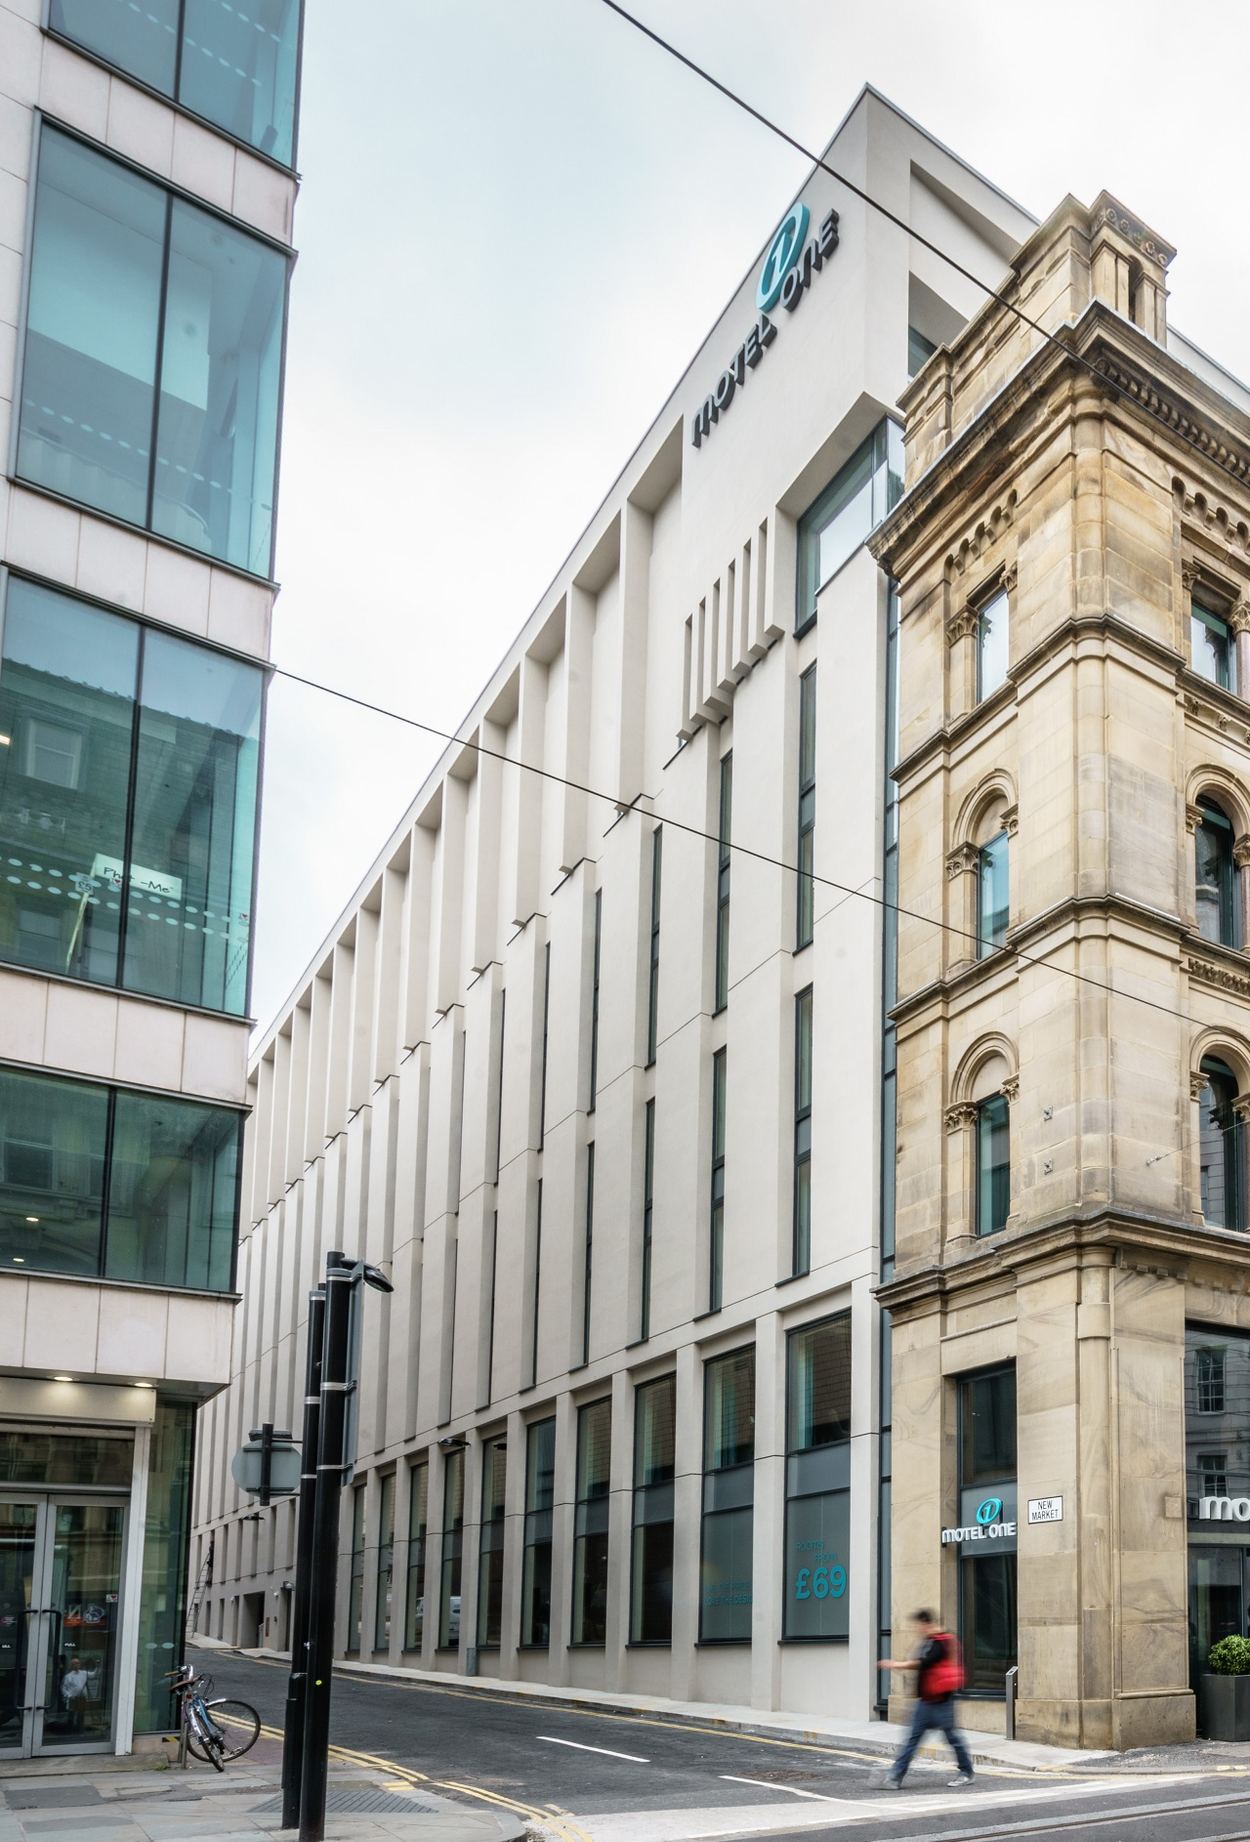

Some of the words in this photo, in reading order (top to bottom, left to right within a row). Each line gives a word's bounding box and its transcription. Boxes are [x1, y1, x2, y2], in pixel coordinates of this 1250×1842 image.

[1037, 1500, 1053, 1510] NEW
[1031, 1509, 1059, 1520] MARKET
[941, 1526, 986, 1543] MOTEL
[988, 1522, 1016, 1538] ONE
[795, 1564, 847, 1600] £69
